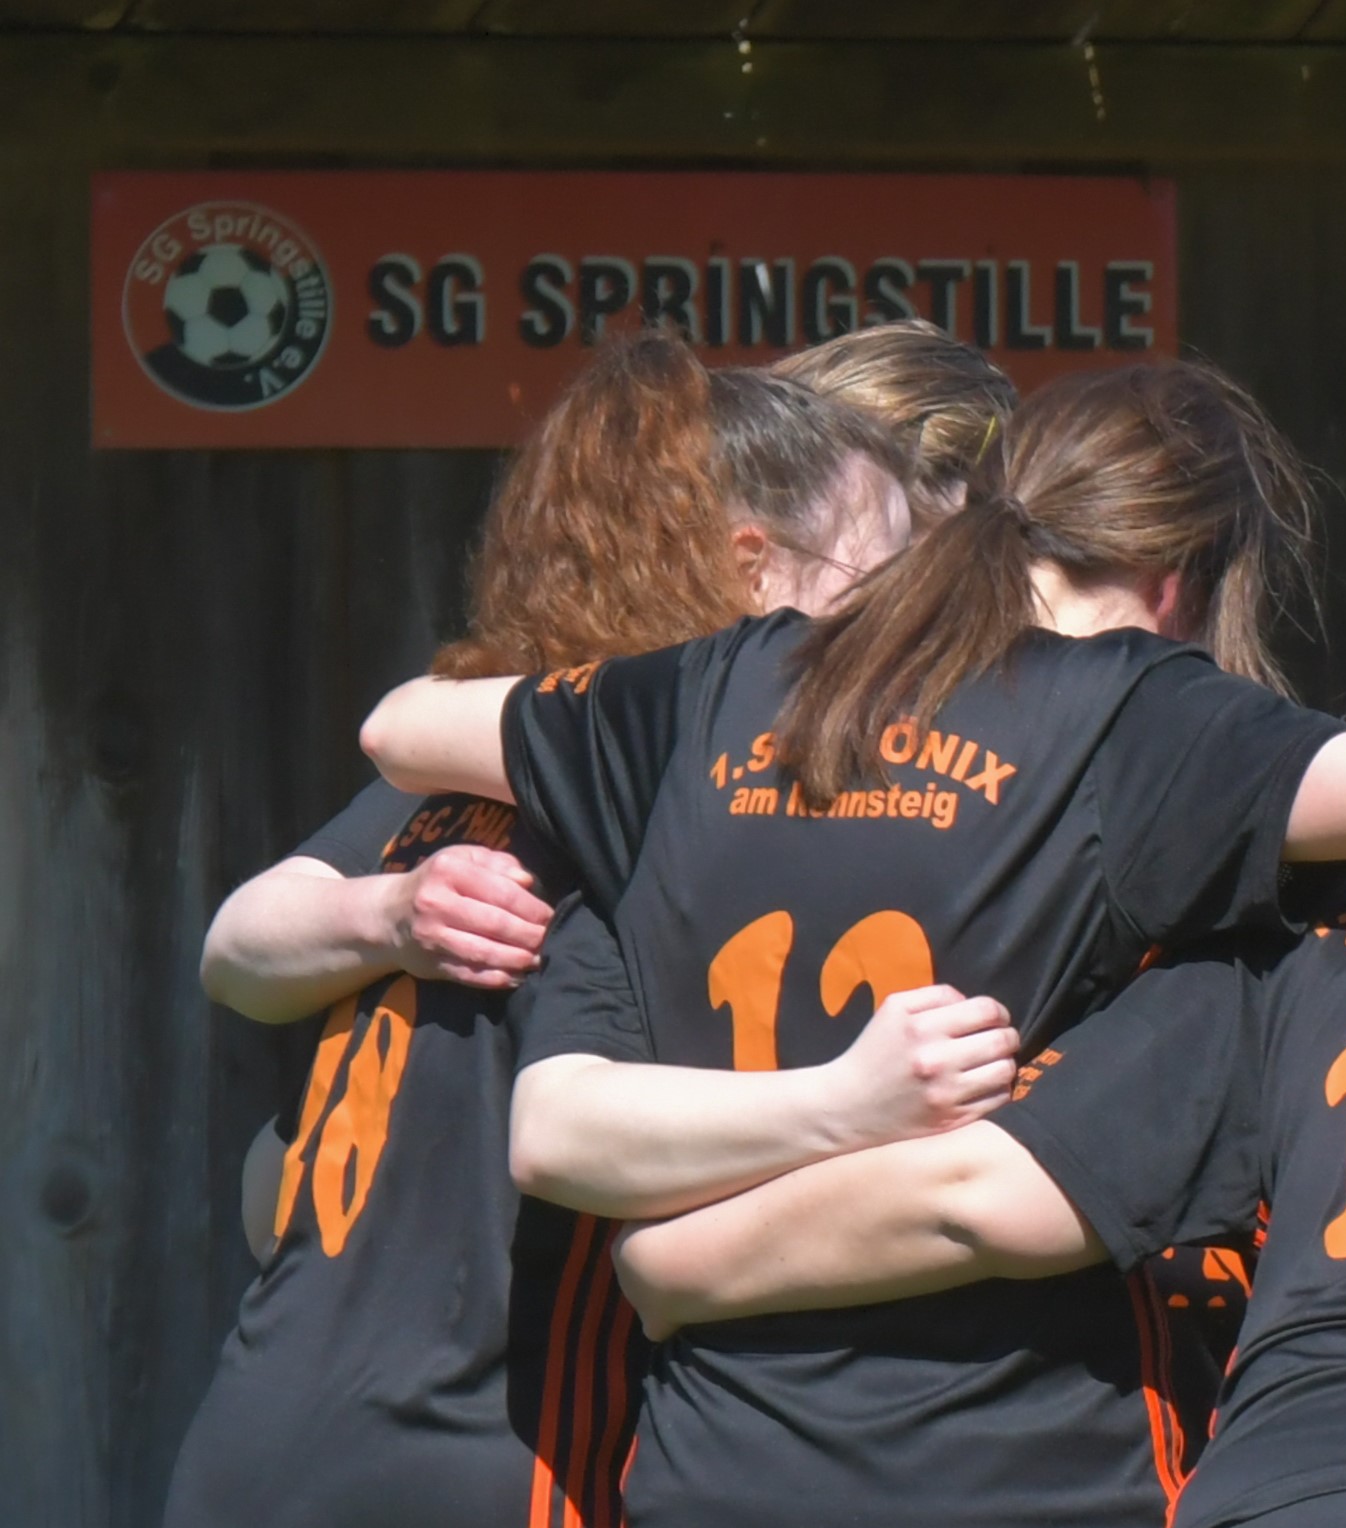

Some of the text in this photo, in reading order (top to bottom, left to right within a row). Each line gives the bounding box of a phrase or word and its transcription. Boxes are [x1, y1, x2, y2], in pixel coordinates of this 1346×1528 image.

[135, 232, 183, 286] SG
[186, 206, 327, 341] Springstille
[369, 252, 1155, 350] SG SPRINGSTILLE
[728, 786, 779, 816] am
